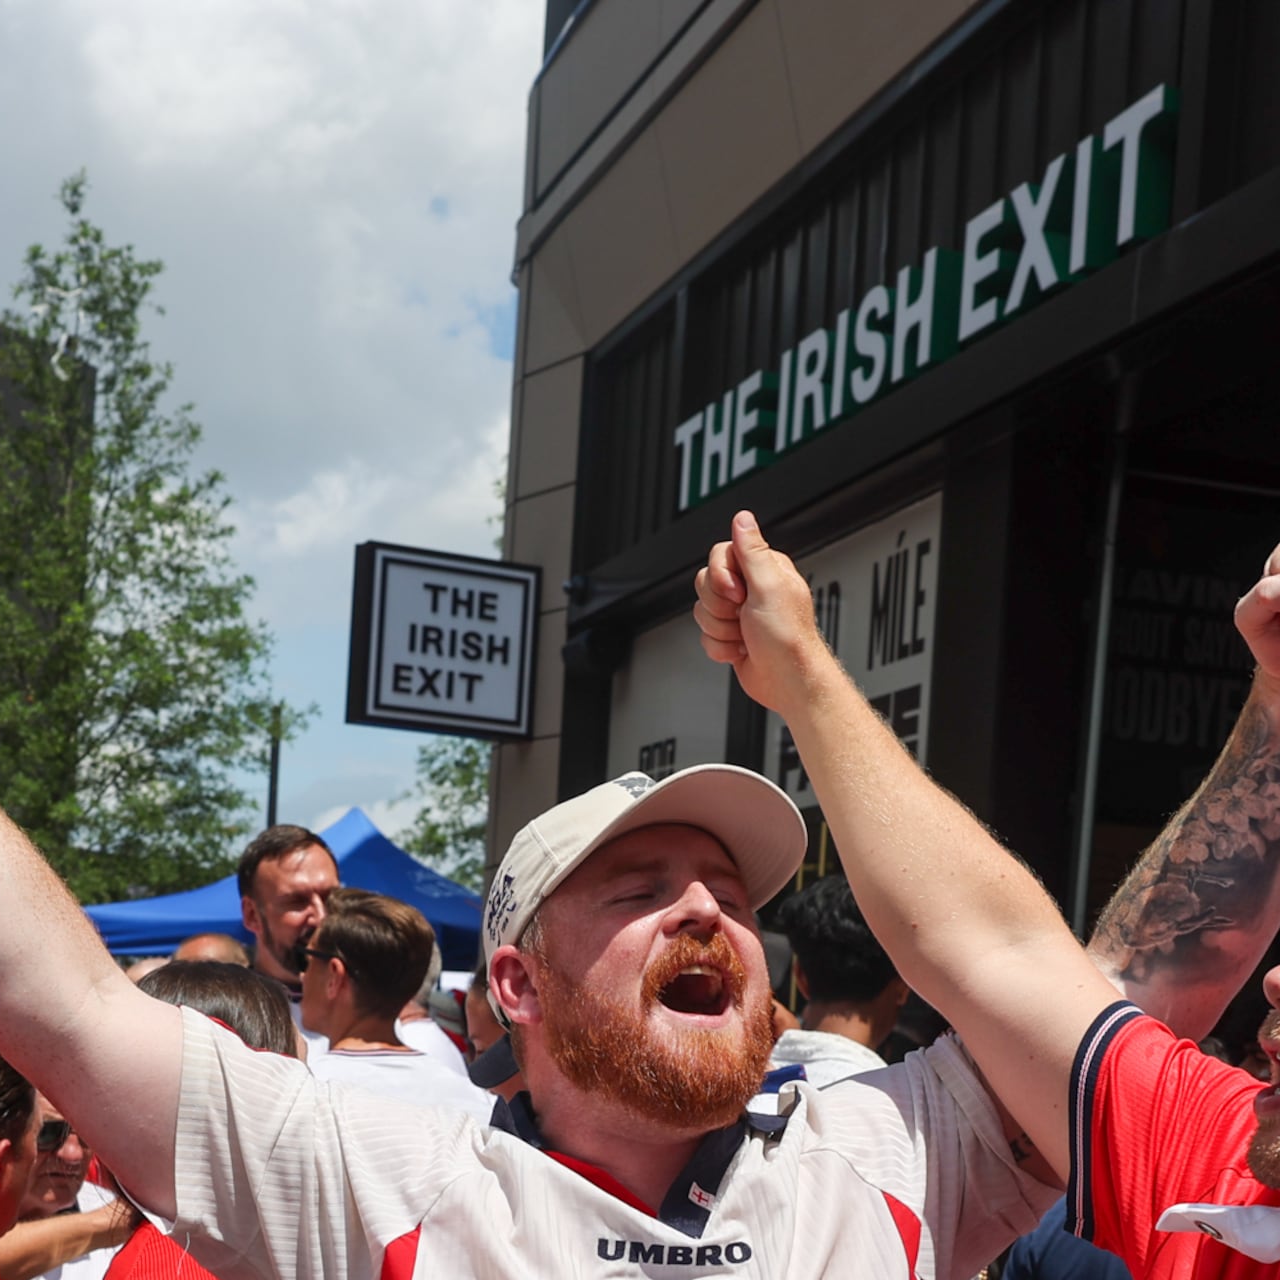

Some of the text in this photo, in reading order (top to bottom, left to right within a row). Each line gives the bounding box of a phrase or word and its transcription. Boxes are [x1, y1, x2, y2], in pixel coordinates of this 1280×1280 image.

[675, 83, 1166, 511] THE IRISH EXIT
[423, 582, 499, 623] THE
[408, 623, 510, 666] IRISH
[391, 663, 484, 703] EXIT
[597, 1238, 752, 1267] UMBRO
